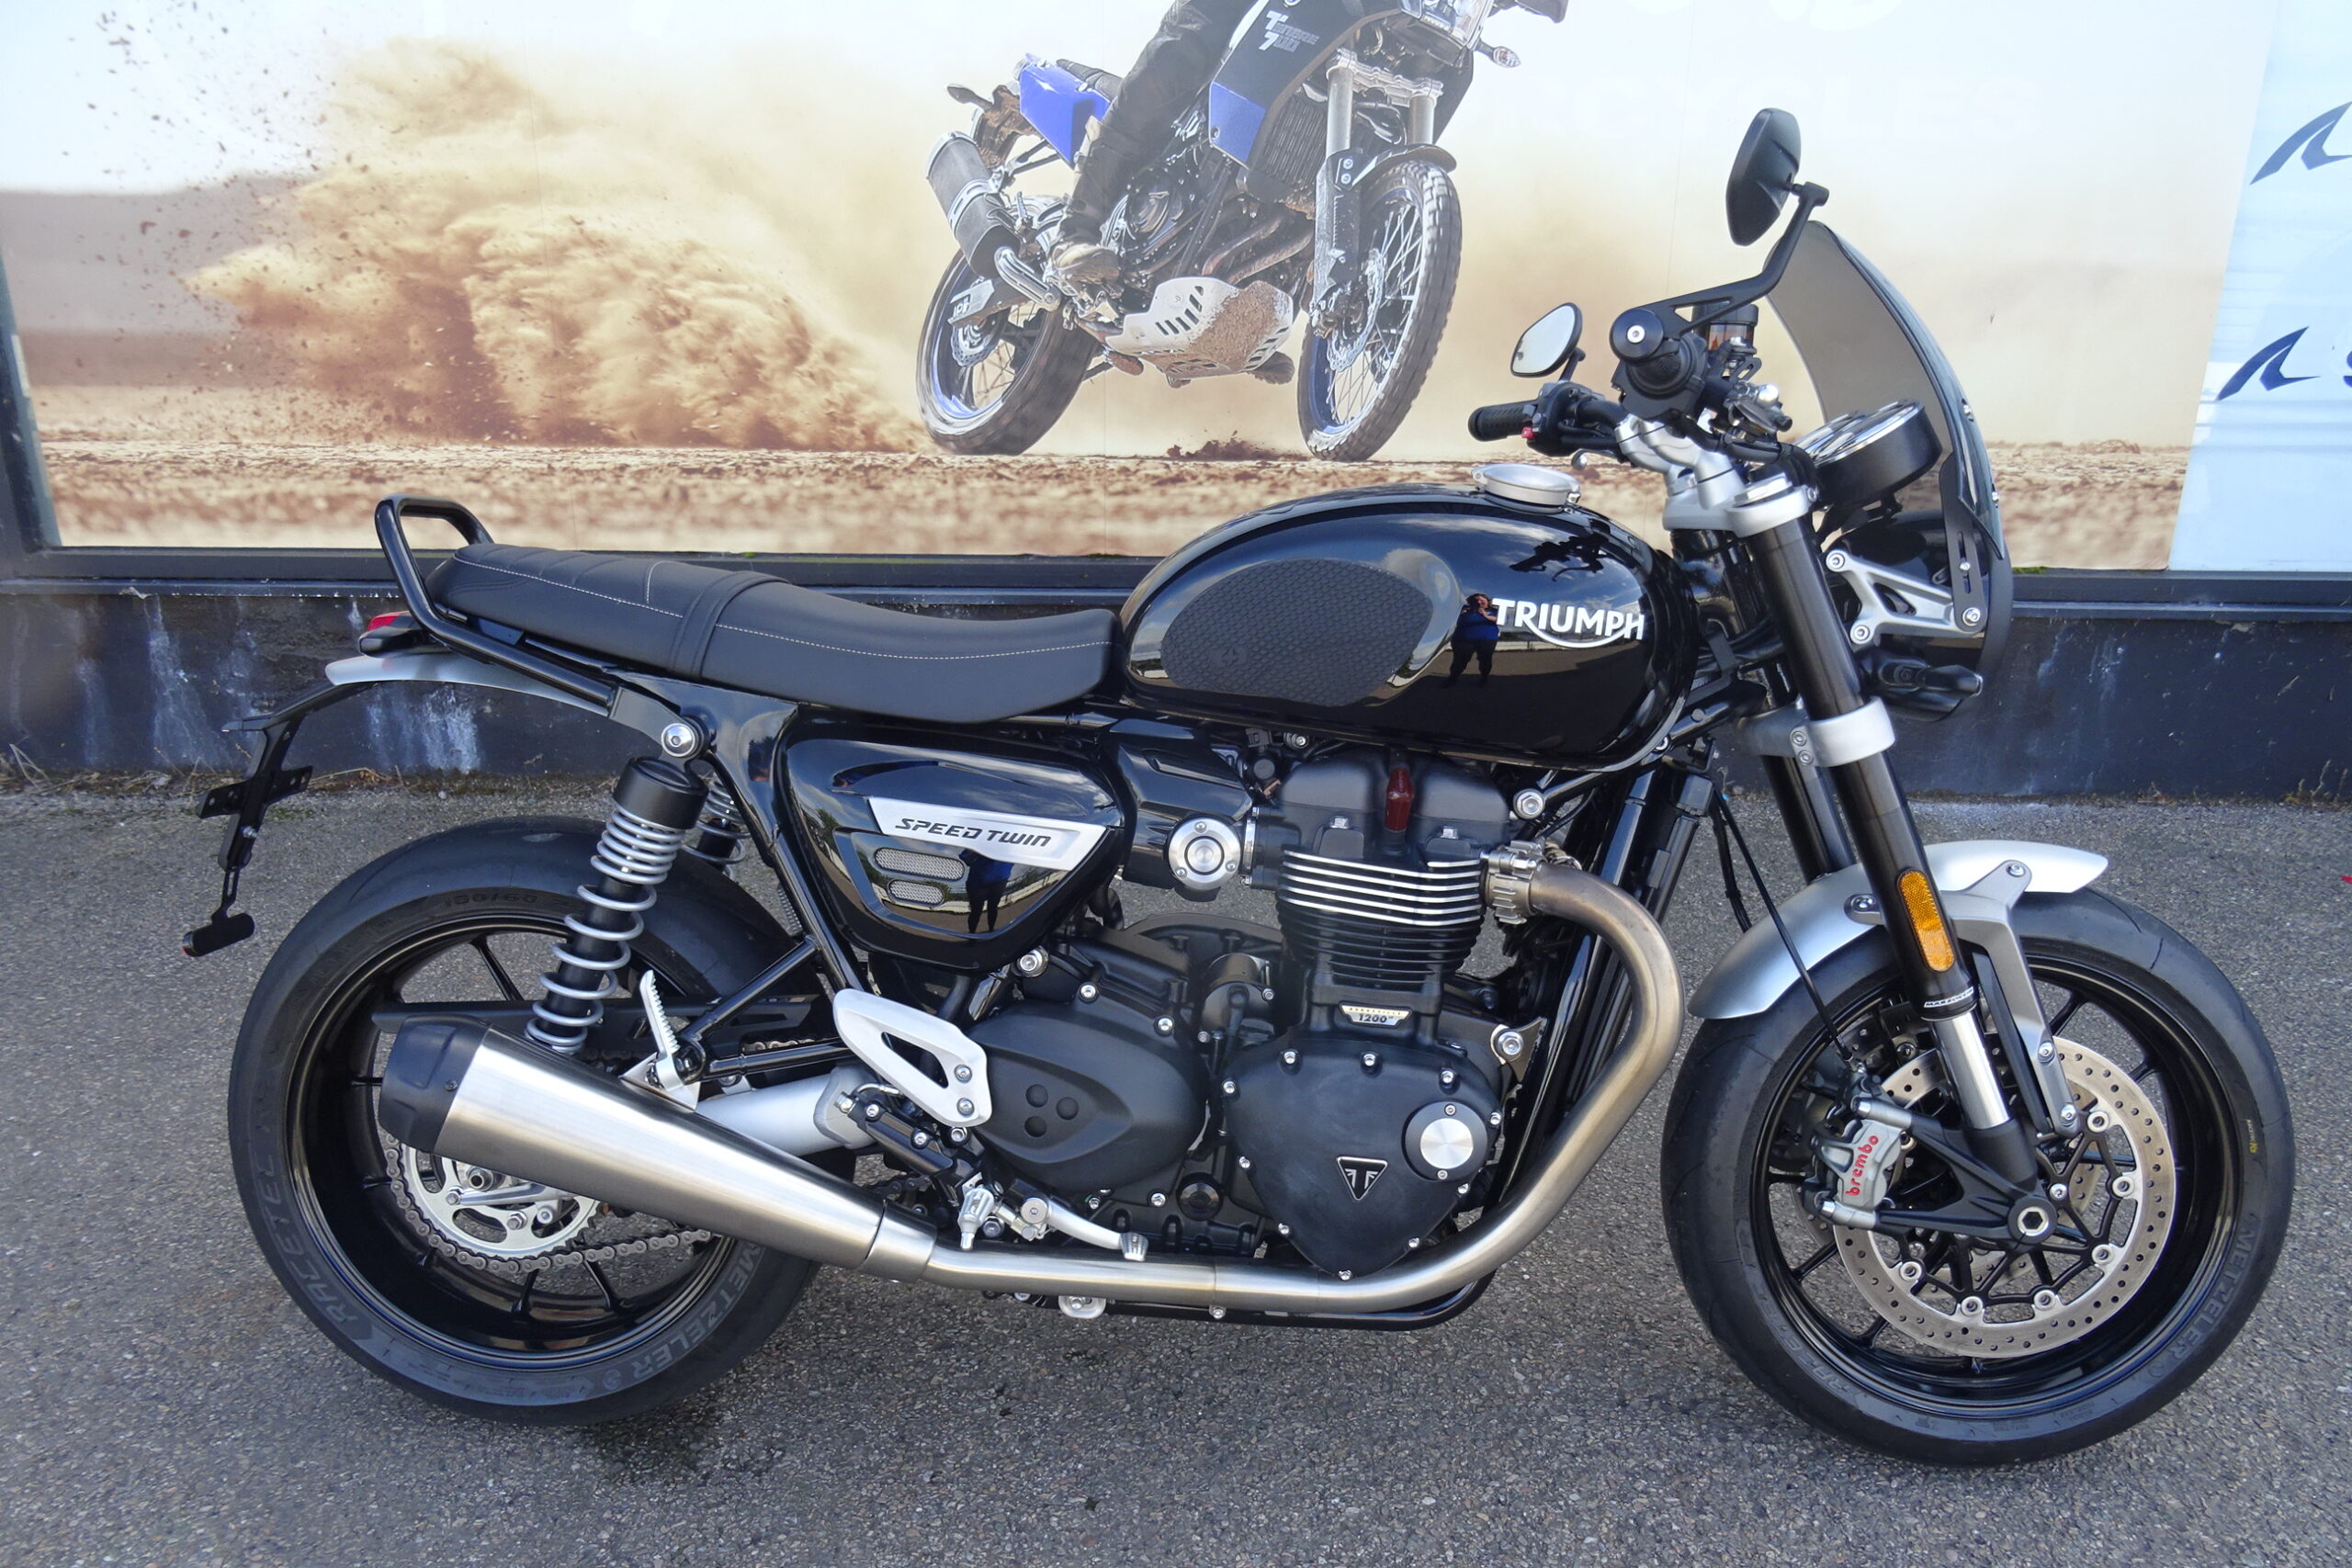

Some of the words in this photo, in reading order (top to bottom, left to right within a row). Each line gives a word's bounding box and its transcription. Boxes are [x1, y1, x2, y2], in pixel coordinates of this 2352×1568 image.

[1491, 598, 1645, 649] TRIUMPH
[895, 818, 982, 840] SPEED
[986, 829, 1051, 847] TWIN
[1359, 1013, 1387, 1023] 1200
[1845, 1135, 1880, 1197] brembo
[254, 1153, 359, 1325] RACETEC
[630, 1242, 762, 1381] METZELER
[2168, 1228, 2256, 1360] METZELER
